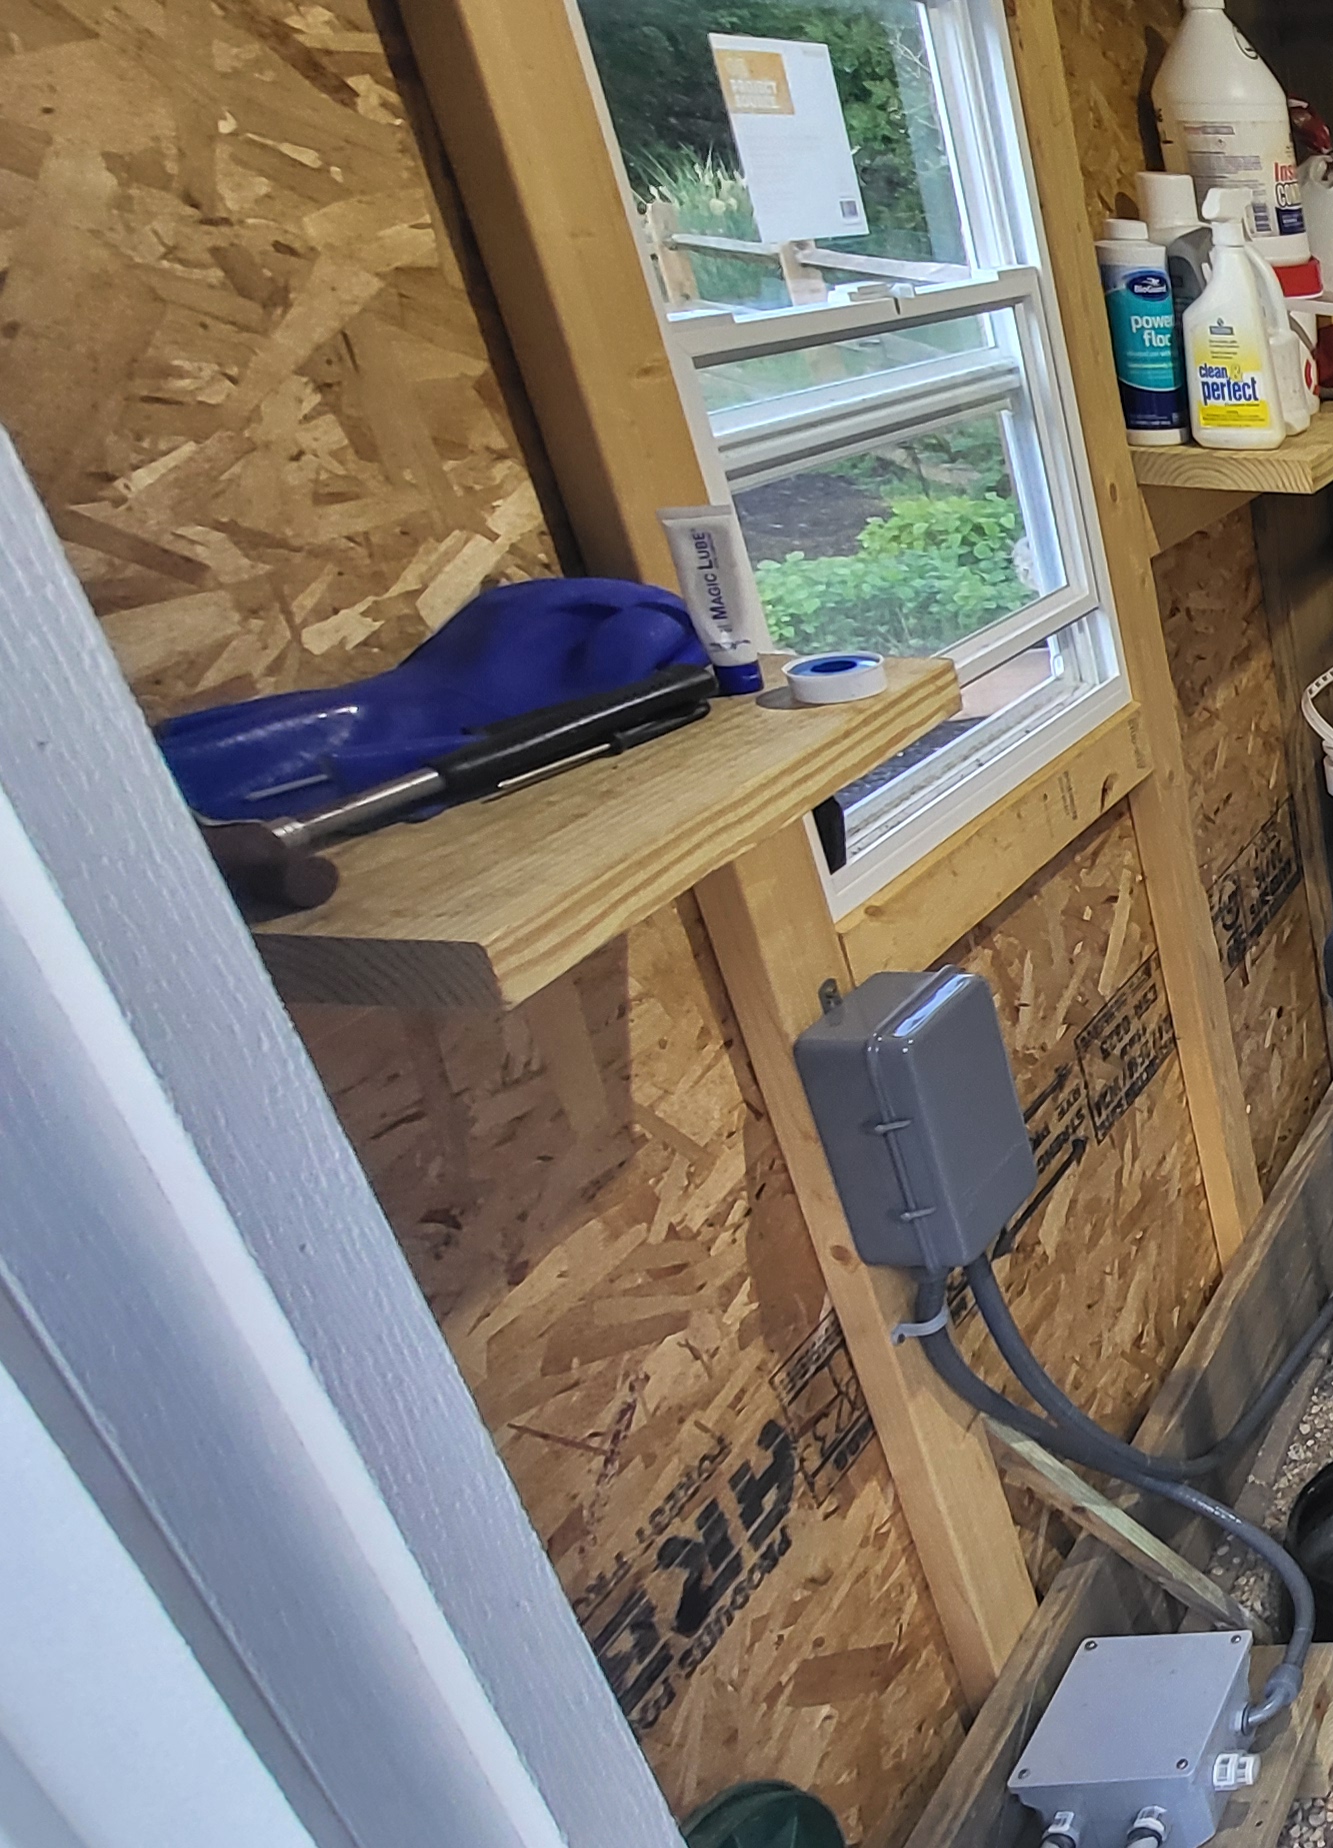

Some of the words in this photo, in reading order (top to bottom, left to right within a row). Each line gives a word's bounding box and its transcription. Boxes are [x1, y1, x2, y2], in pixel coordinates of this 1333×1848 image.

[1199, 363, 1228, 379] clean
[1201, 377, 1260, 406] perfect
[691, 532, 712, 570] LUBE
[703, 573, 727, 620] MAGIC
